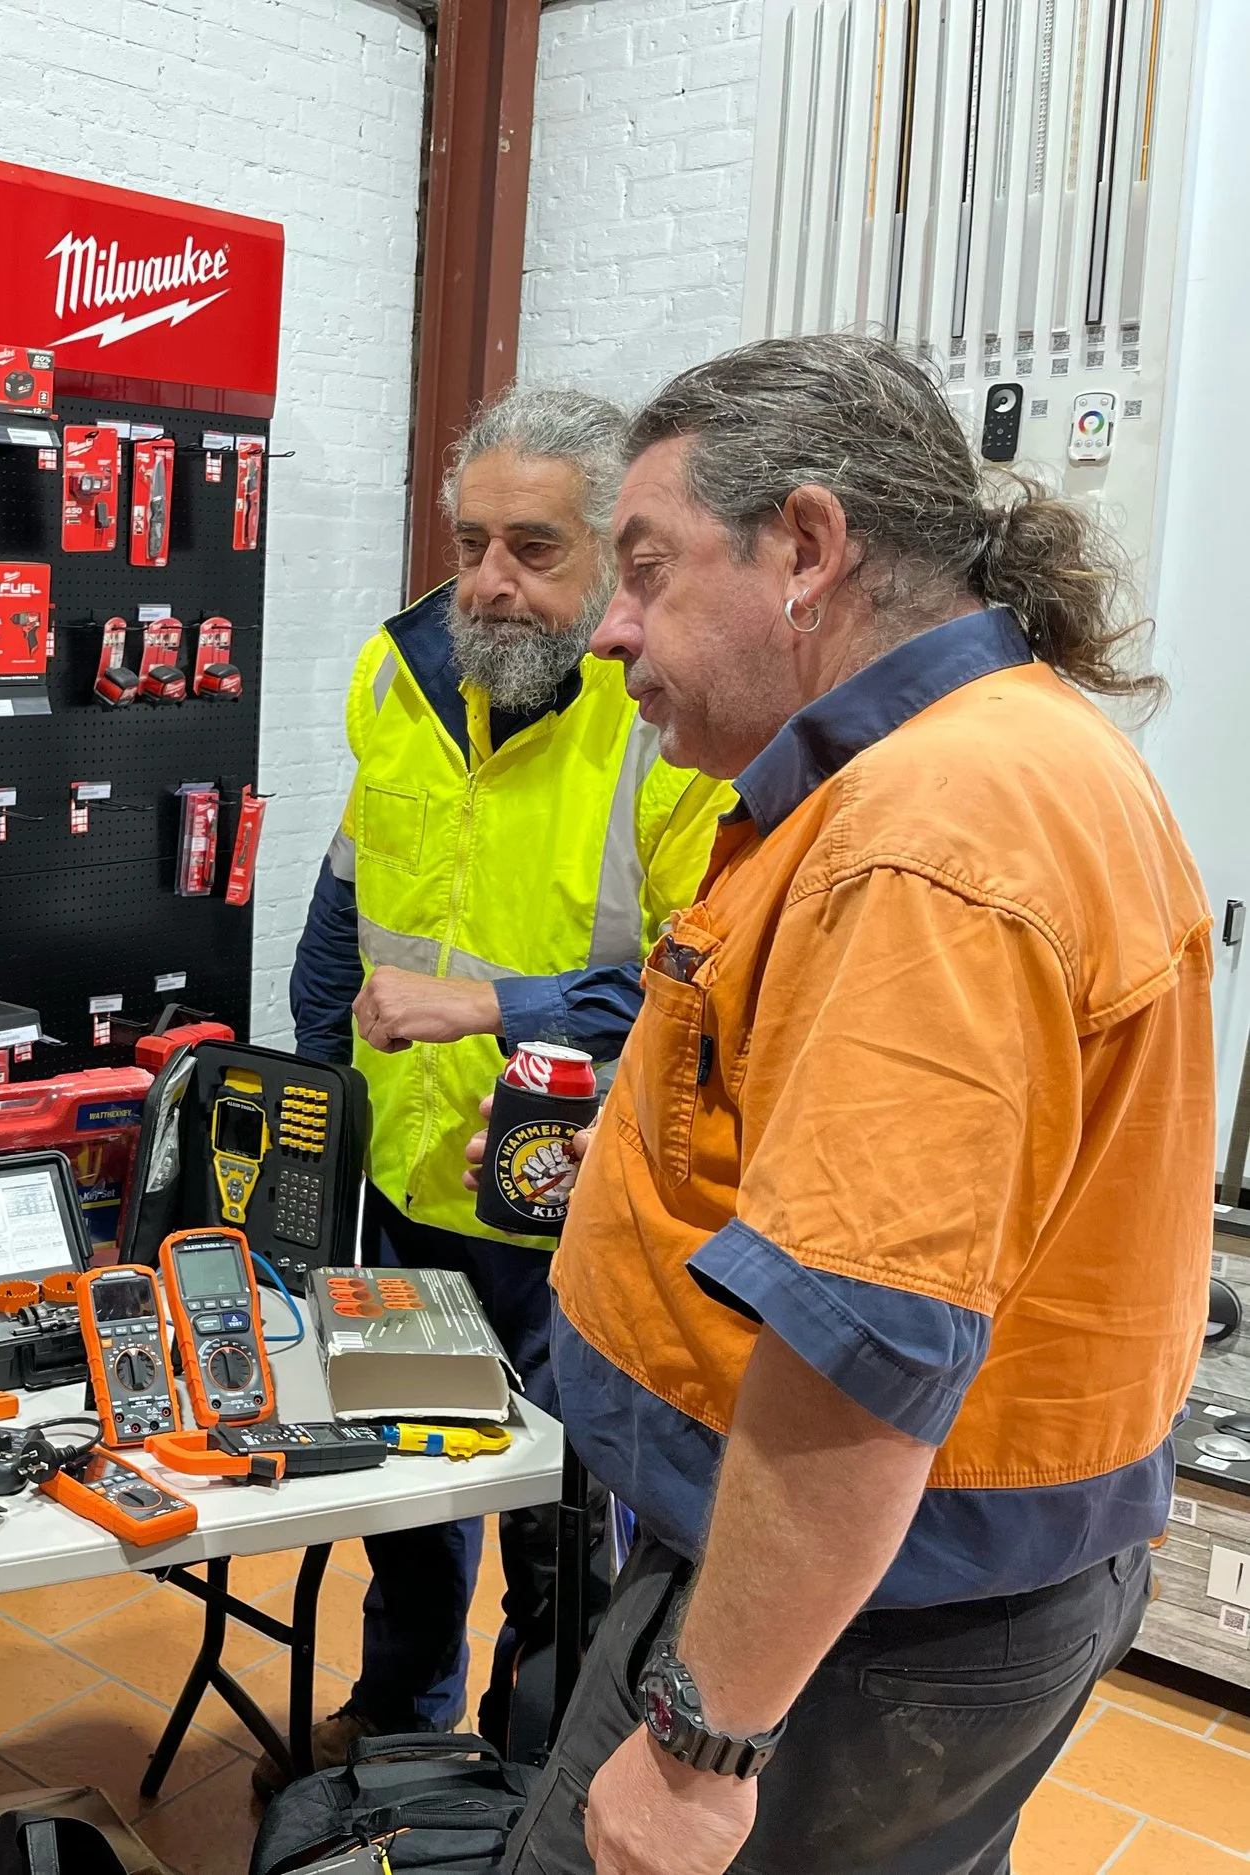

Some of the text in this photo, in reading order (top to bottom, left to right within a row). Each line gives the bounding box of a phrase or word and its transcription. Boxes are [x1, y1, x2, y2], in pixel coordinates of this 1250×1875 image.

[46, 230, 231, 315] Milwaukee
[0, 583, 41, 593] FUEL
[89, 1109, 132, 1120] WATTHEXKEY
[499, 1124, 561, 1201] NOT A HAMMER
[101, 1188, 115, 1199] Set
